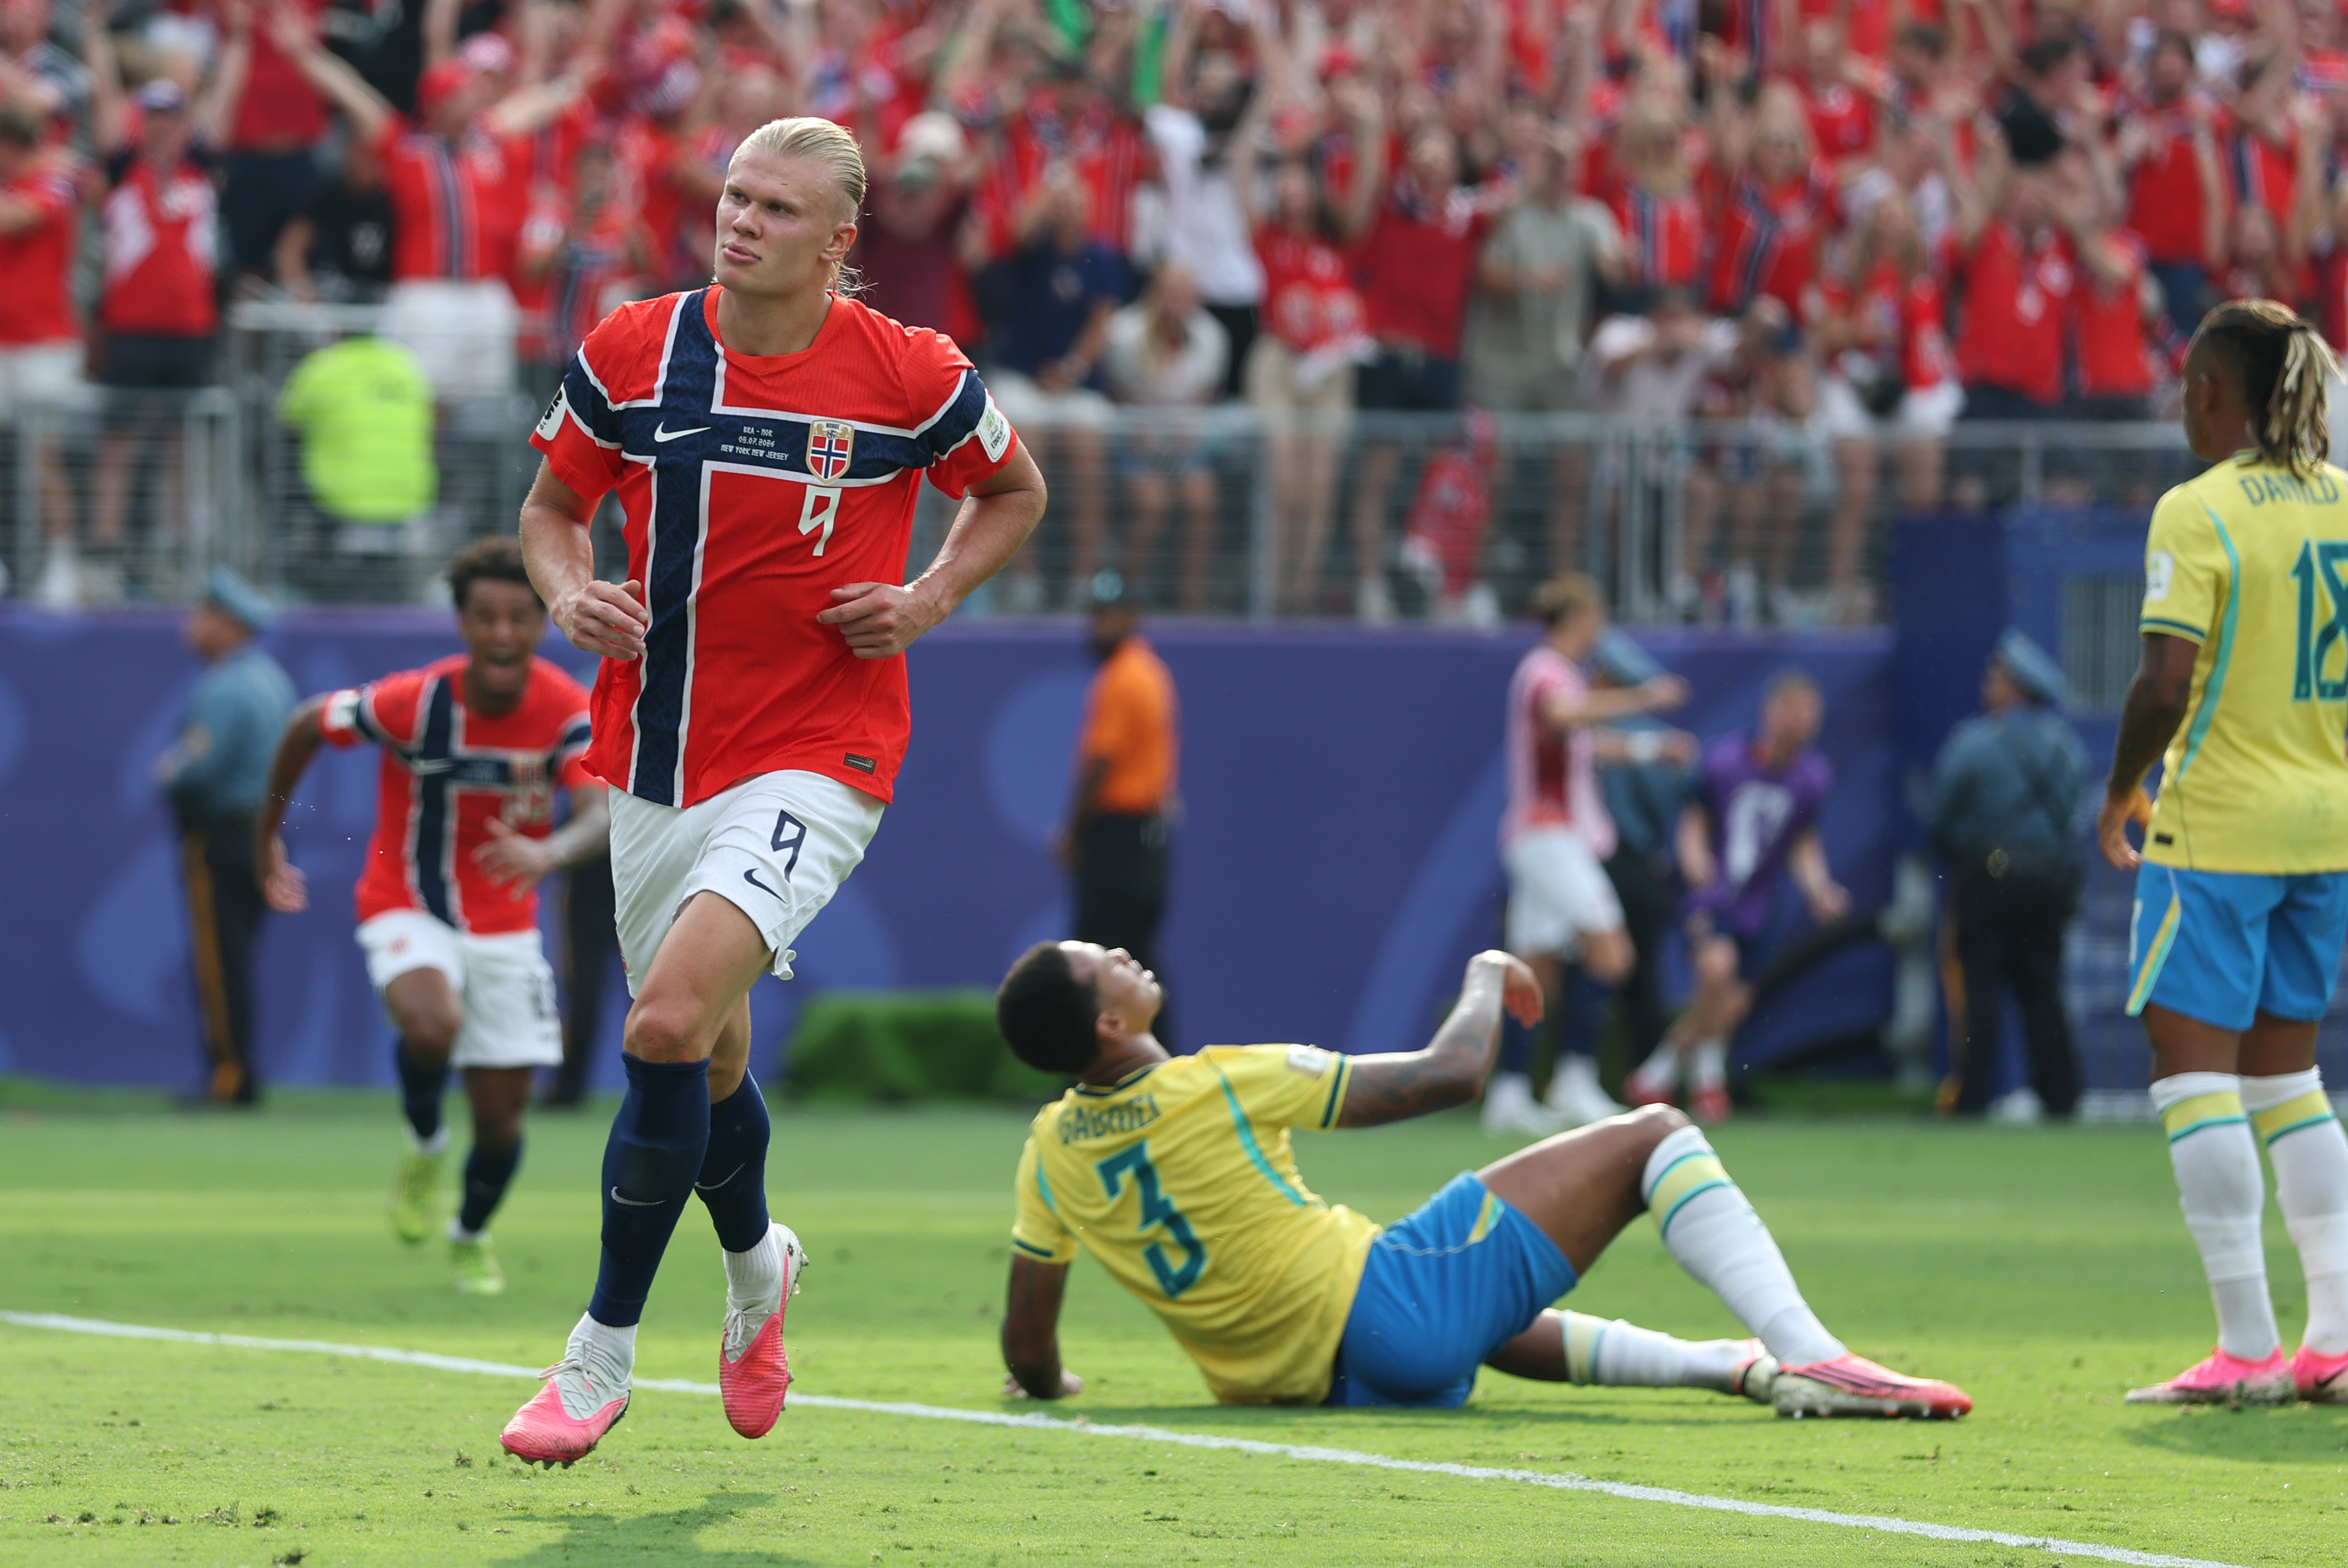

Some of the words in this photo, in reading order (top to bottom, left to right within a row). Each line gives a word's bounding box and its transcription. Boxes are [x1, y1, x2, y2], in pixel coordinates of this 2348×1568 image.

[735, 446, 751, 456] YORK
[751, 449, 765, 457] NEW
[765, 451, 789, 461] JERSEY
[738, 436, 775, 448] 05.07.2026
[743, 426, 754, 434] BRA
[761, 428, 773, 437] NOR
[798, 484, 843, 557] 9
[770, 809, 807, 884] 9
[1096, 1139, 1208, 1300] 3
